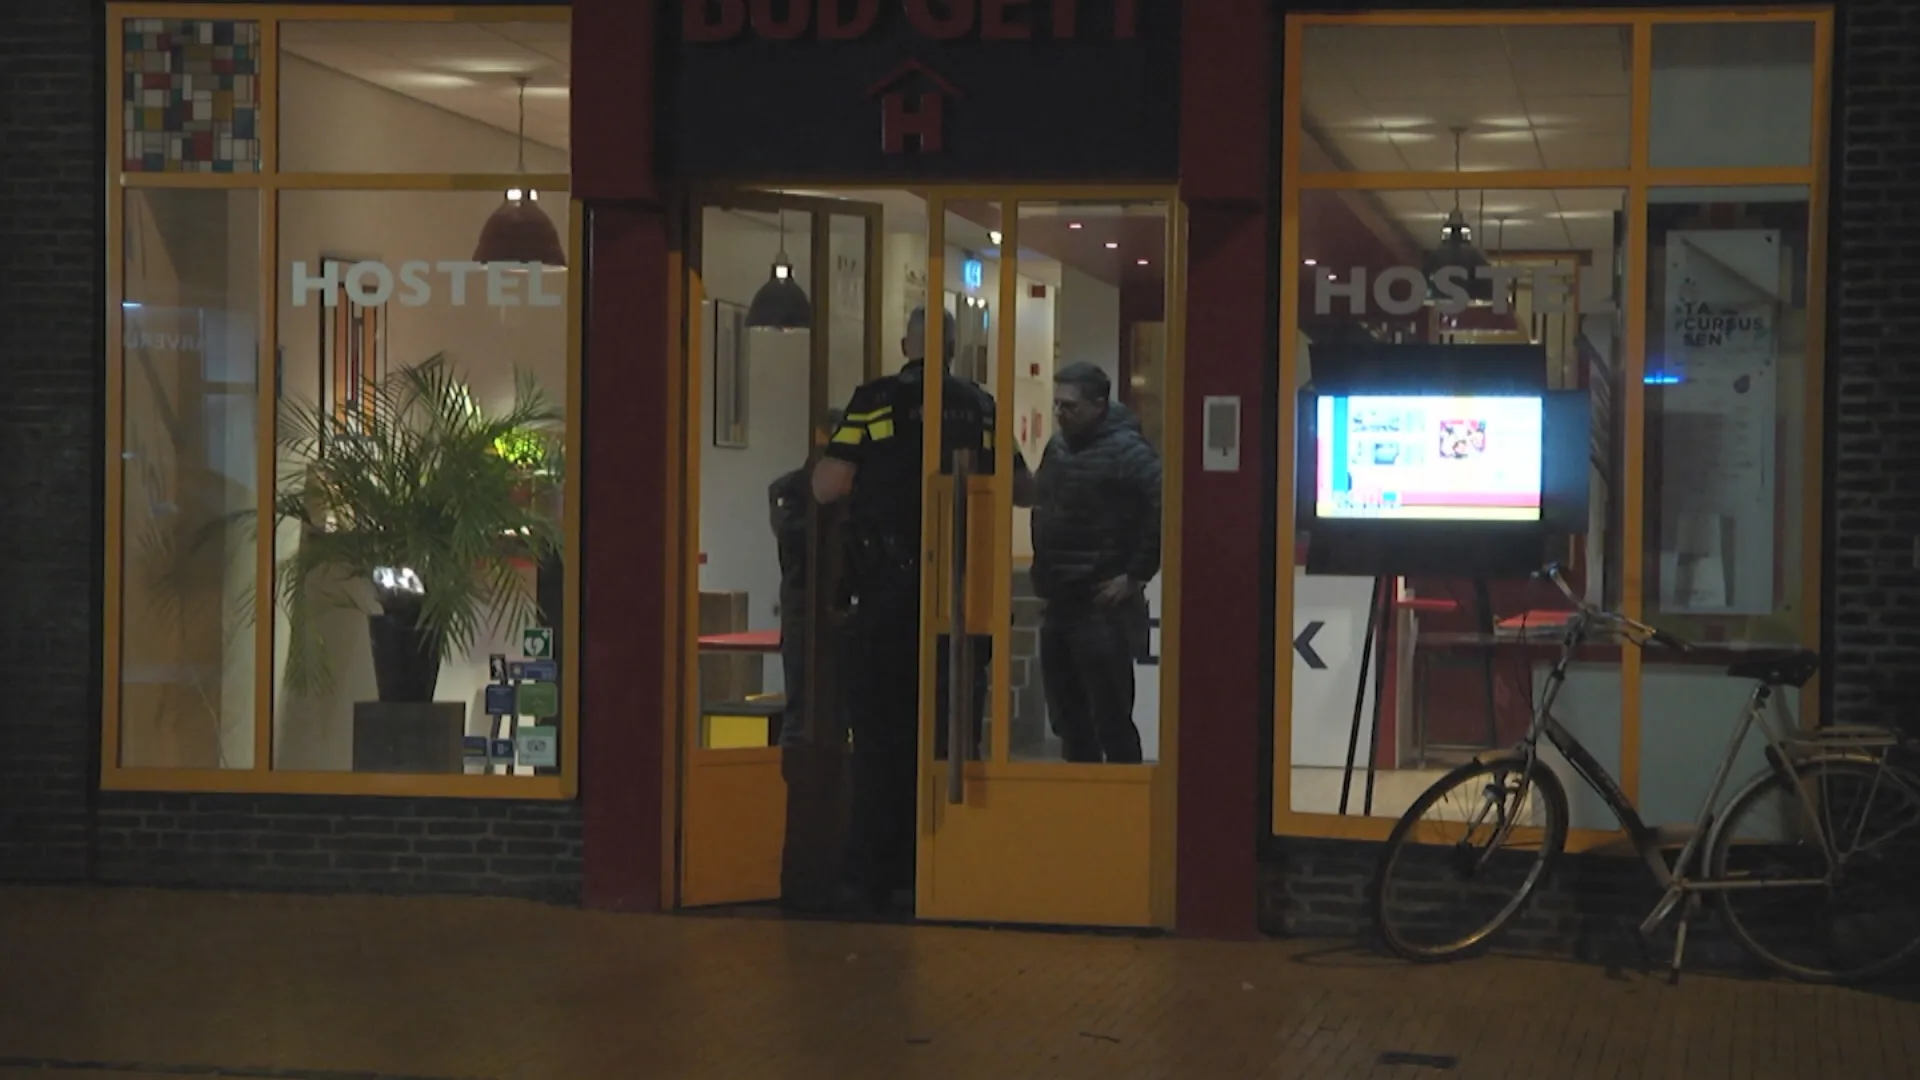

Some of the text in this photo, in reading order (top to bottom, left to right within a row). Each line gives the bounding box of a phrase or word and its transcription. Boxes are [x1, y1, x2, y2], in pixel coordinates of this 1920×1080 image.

[881, 92, 943, 154] H
[292, 260, 561, 307] HOSTEL
[1315, 264, 1615, 315] HOSTEL
